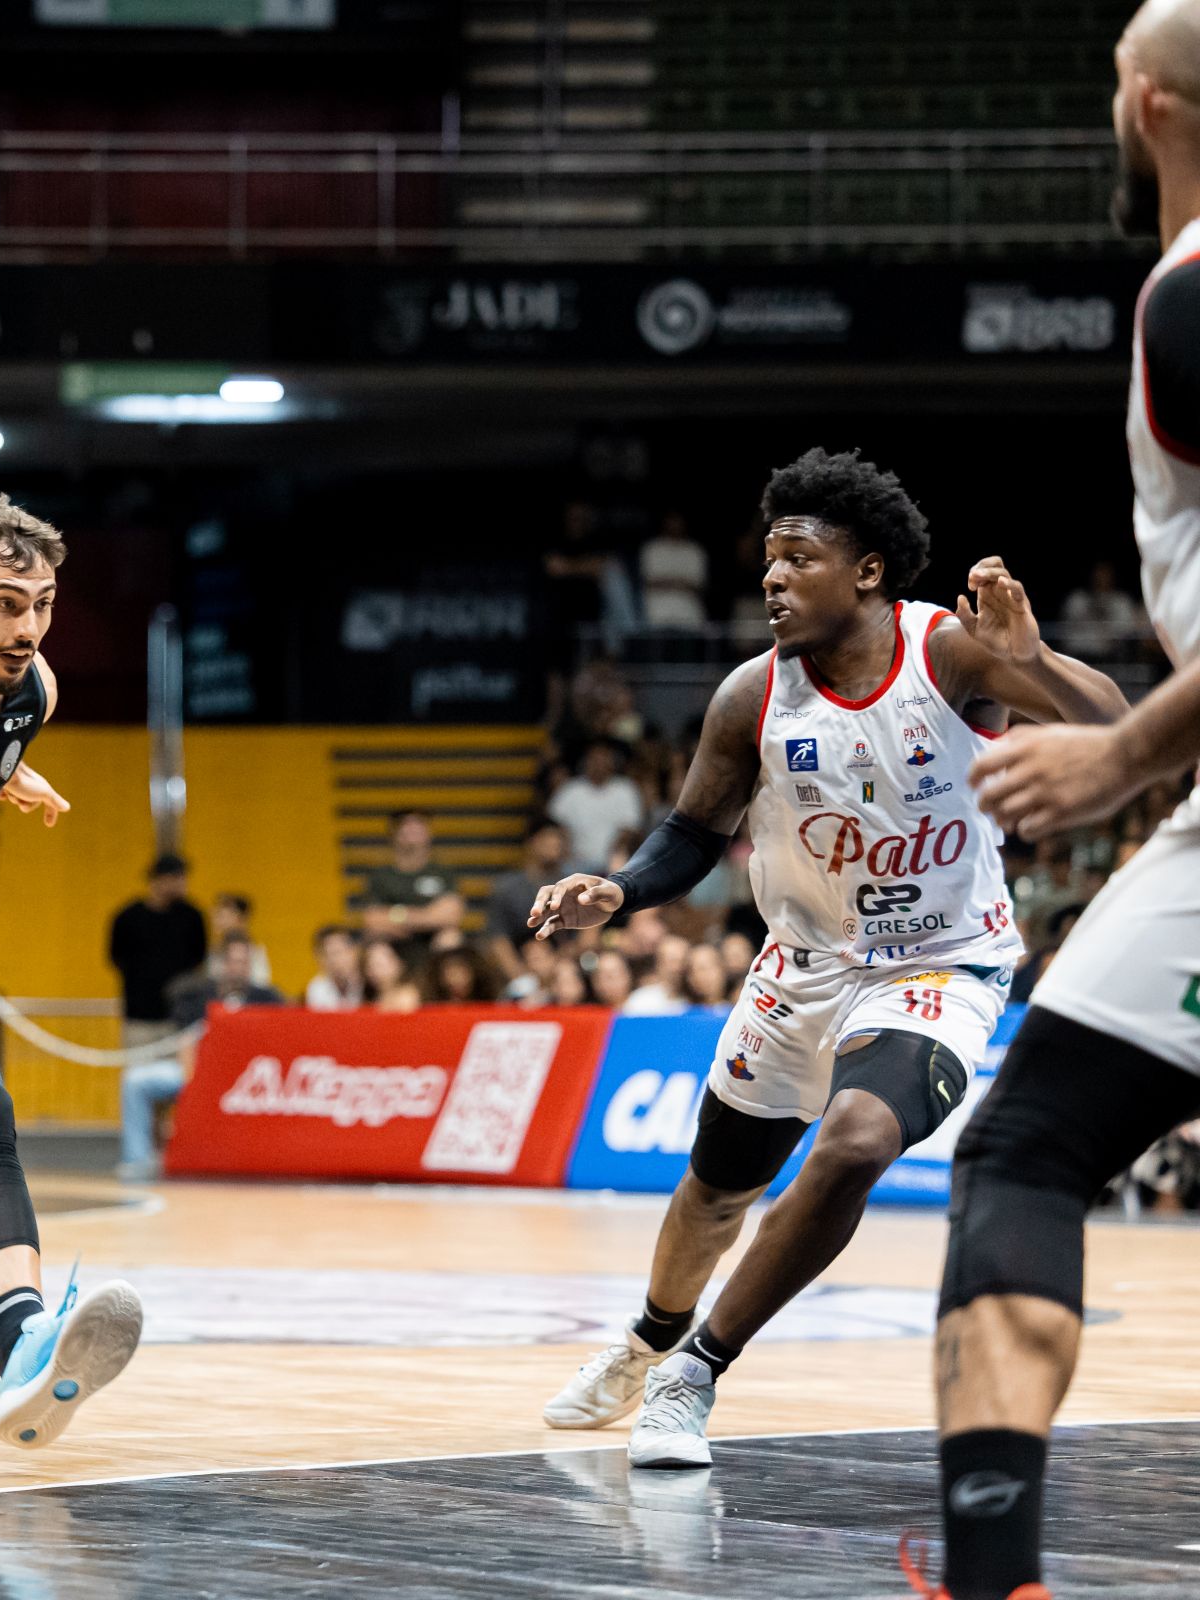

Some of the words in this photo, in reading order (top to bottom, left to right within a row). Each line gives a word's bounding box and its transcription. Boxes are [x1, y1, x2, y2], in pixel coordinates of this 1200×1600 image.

[903, 782, 953, 802] BASSO
[797, 811, 968, 878] Pato
[864, 913, 953, 936] CRESOL
